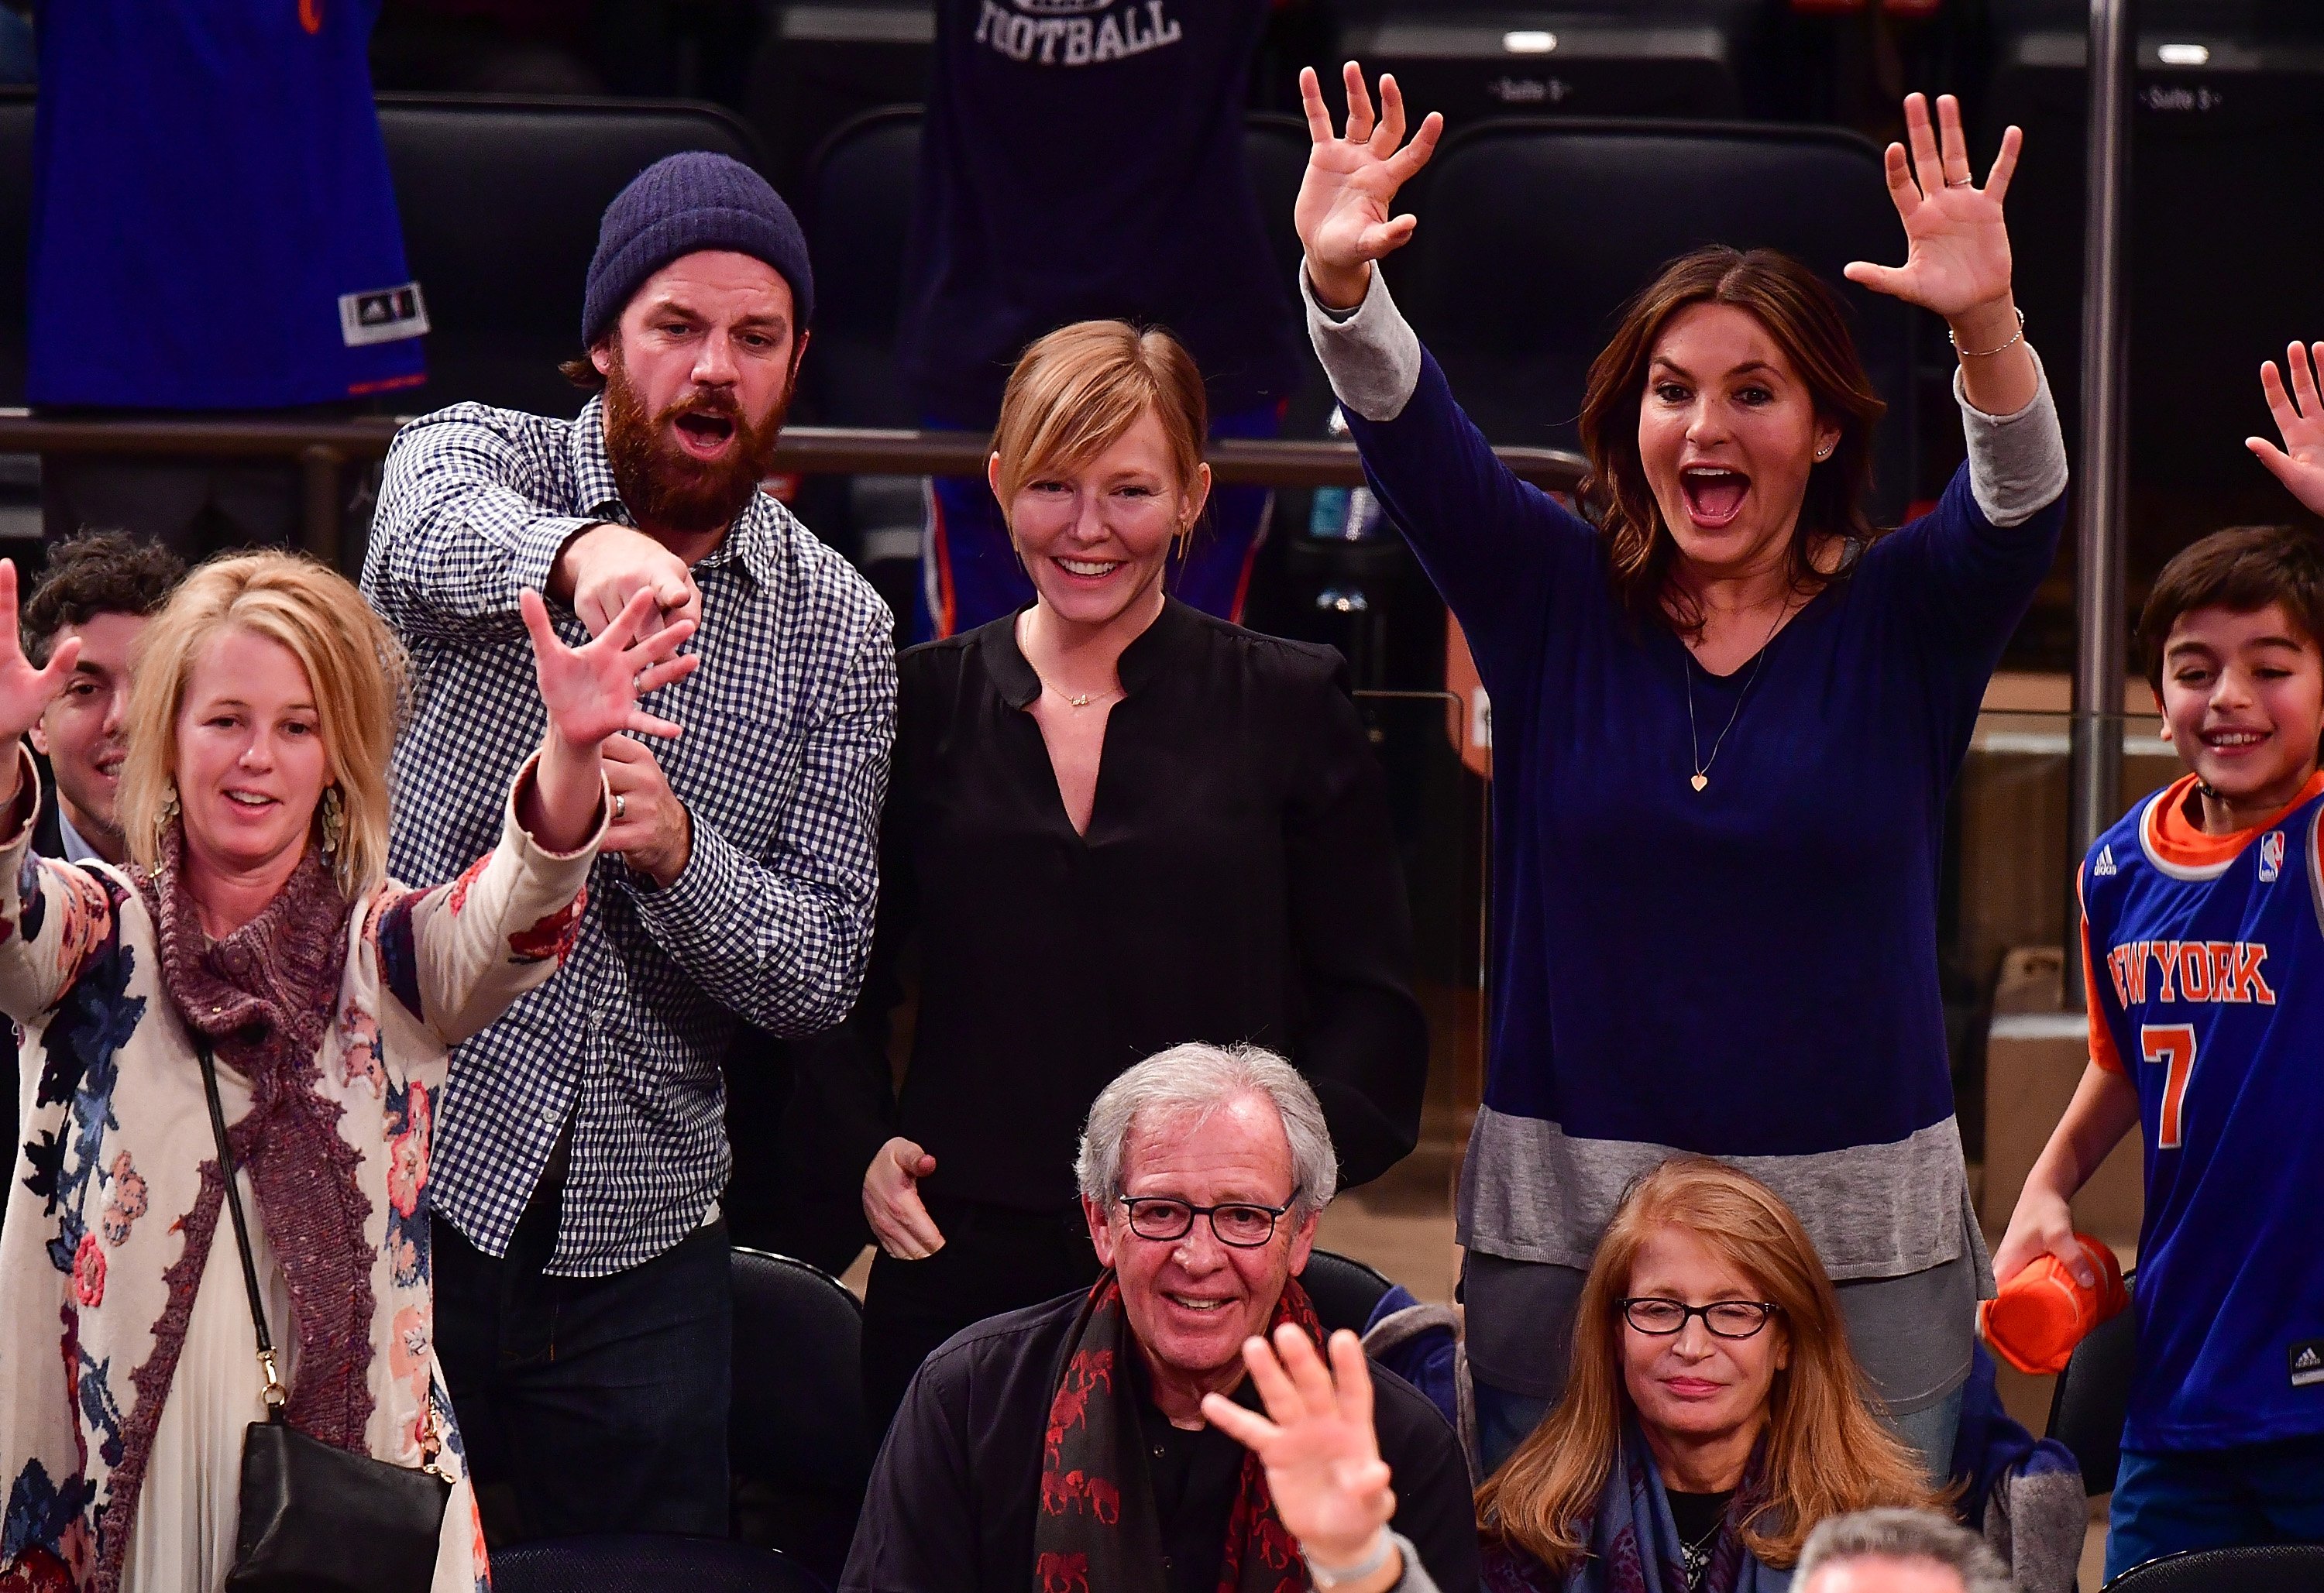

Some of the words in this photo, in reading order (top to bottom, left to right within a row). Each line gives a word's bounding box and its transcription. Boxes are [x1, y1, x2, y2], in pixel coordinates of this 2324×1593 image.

[2094, 863, 2117, 876] adidas
[2150, 939, 2276, 1005] YORK
[2140, 1022, 2197, 1150] 7
